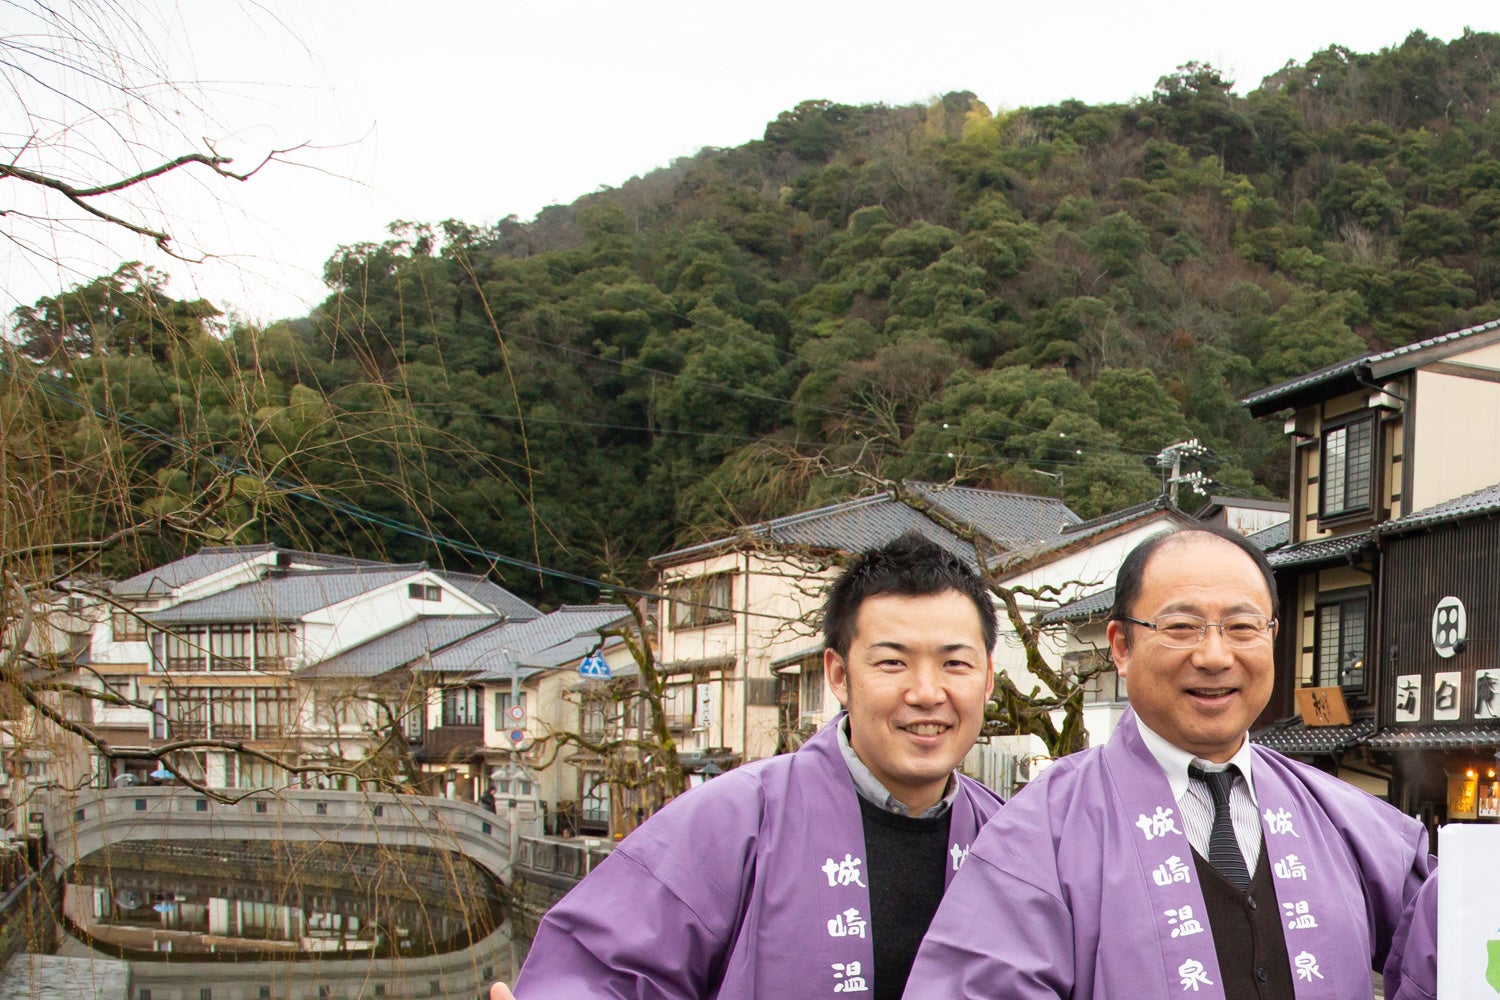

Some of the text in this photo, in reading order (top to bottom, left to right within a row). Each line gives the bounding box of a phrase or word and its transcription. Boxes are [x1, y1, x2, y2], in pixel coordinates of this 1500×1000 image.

[1135, 806, 1214, 991] 城崎温泉
[1263, 807, 1325, 982] 城崎温泉
